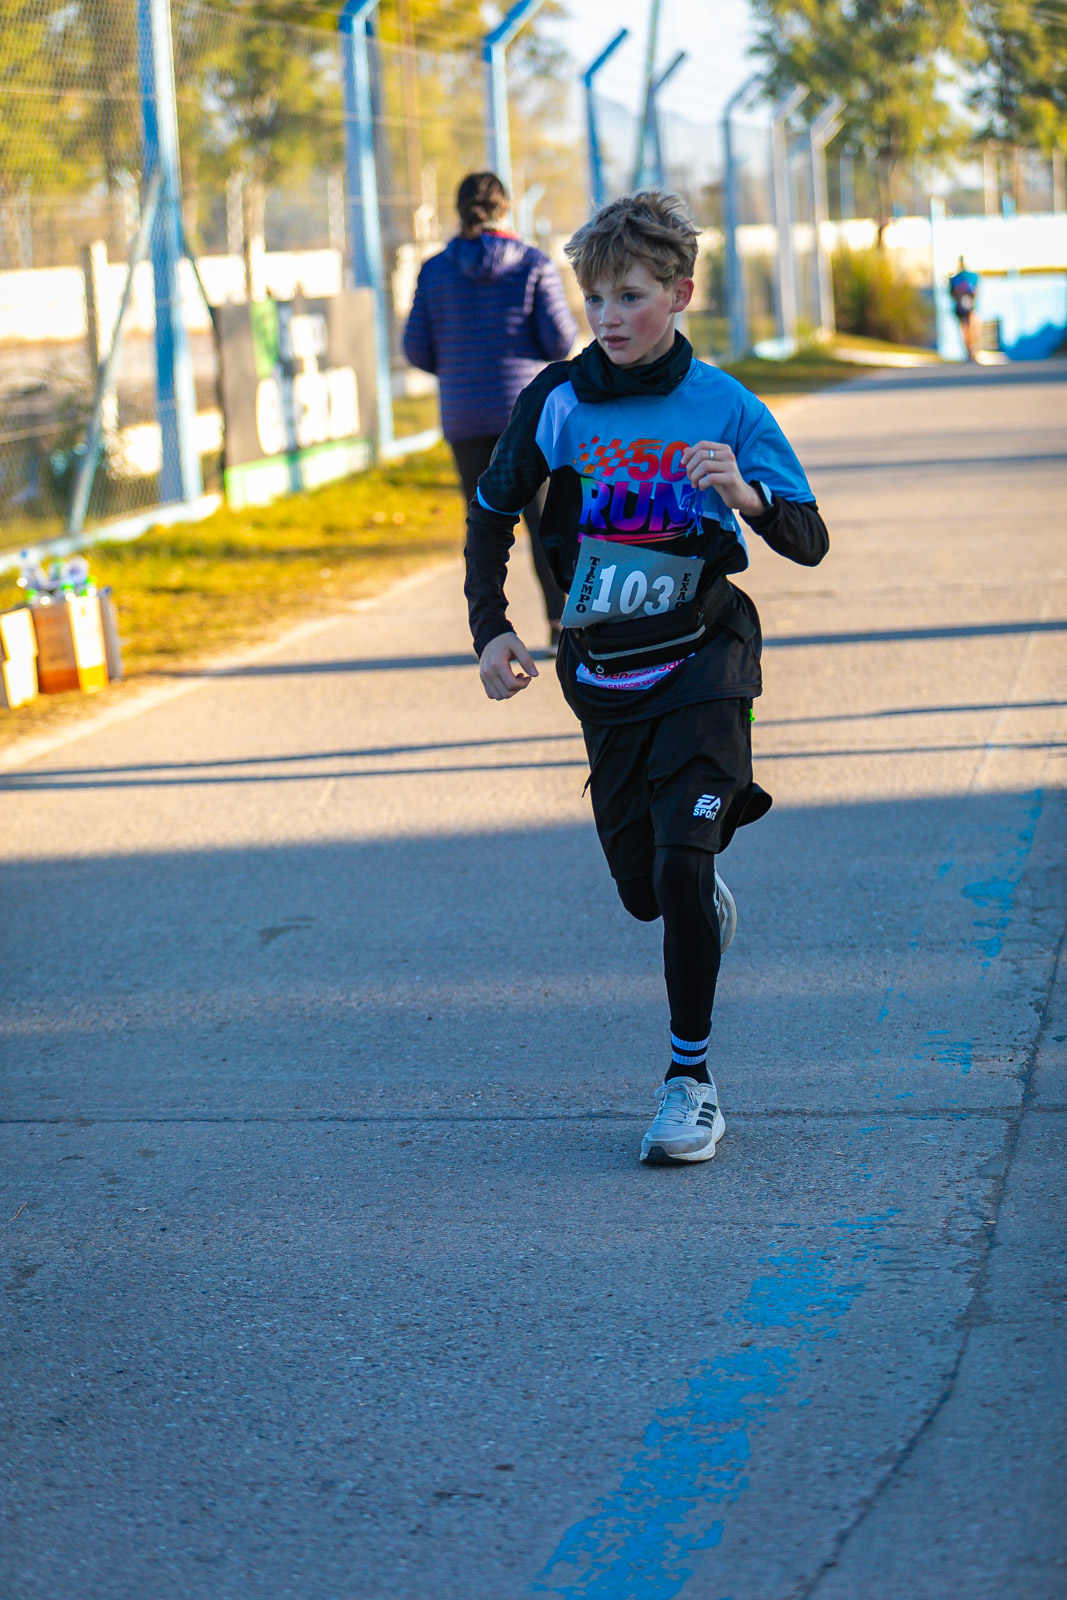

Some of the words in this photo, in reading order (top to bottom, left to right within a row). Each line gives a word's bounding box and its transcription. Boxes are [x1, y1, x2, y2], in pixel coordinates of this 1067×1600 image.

[579, 477, 693, 531] RUN
[576, 556, 601, 613] TIEMPO
[591, 564, 675, 616] 103
[694, 794, 721, 812] EA
